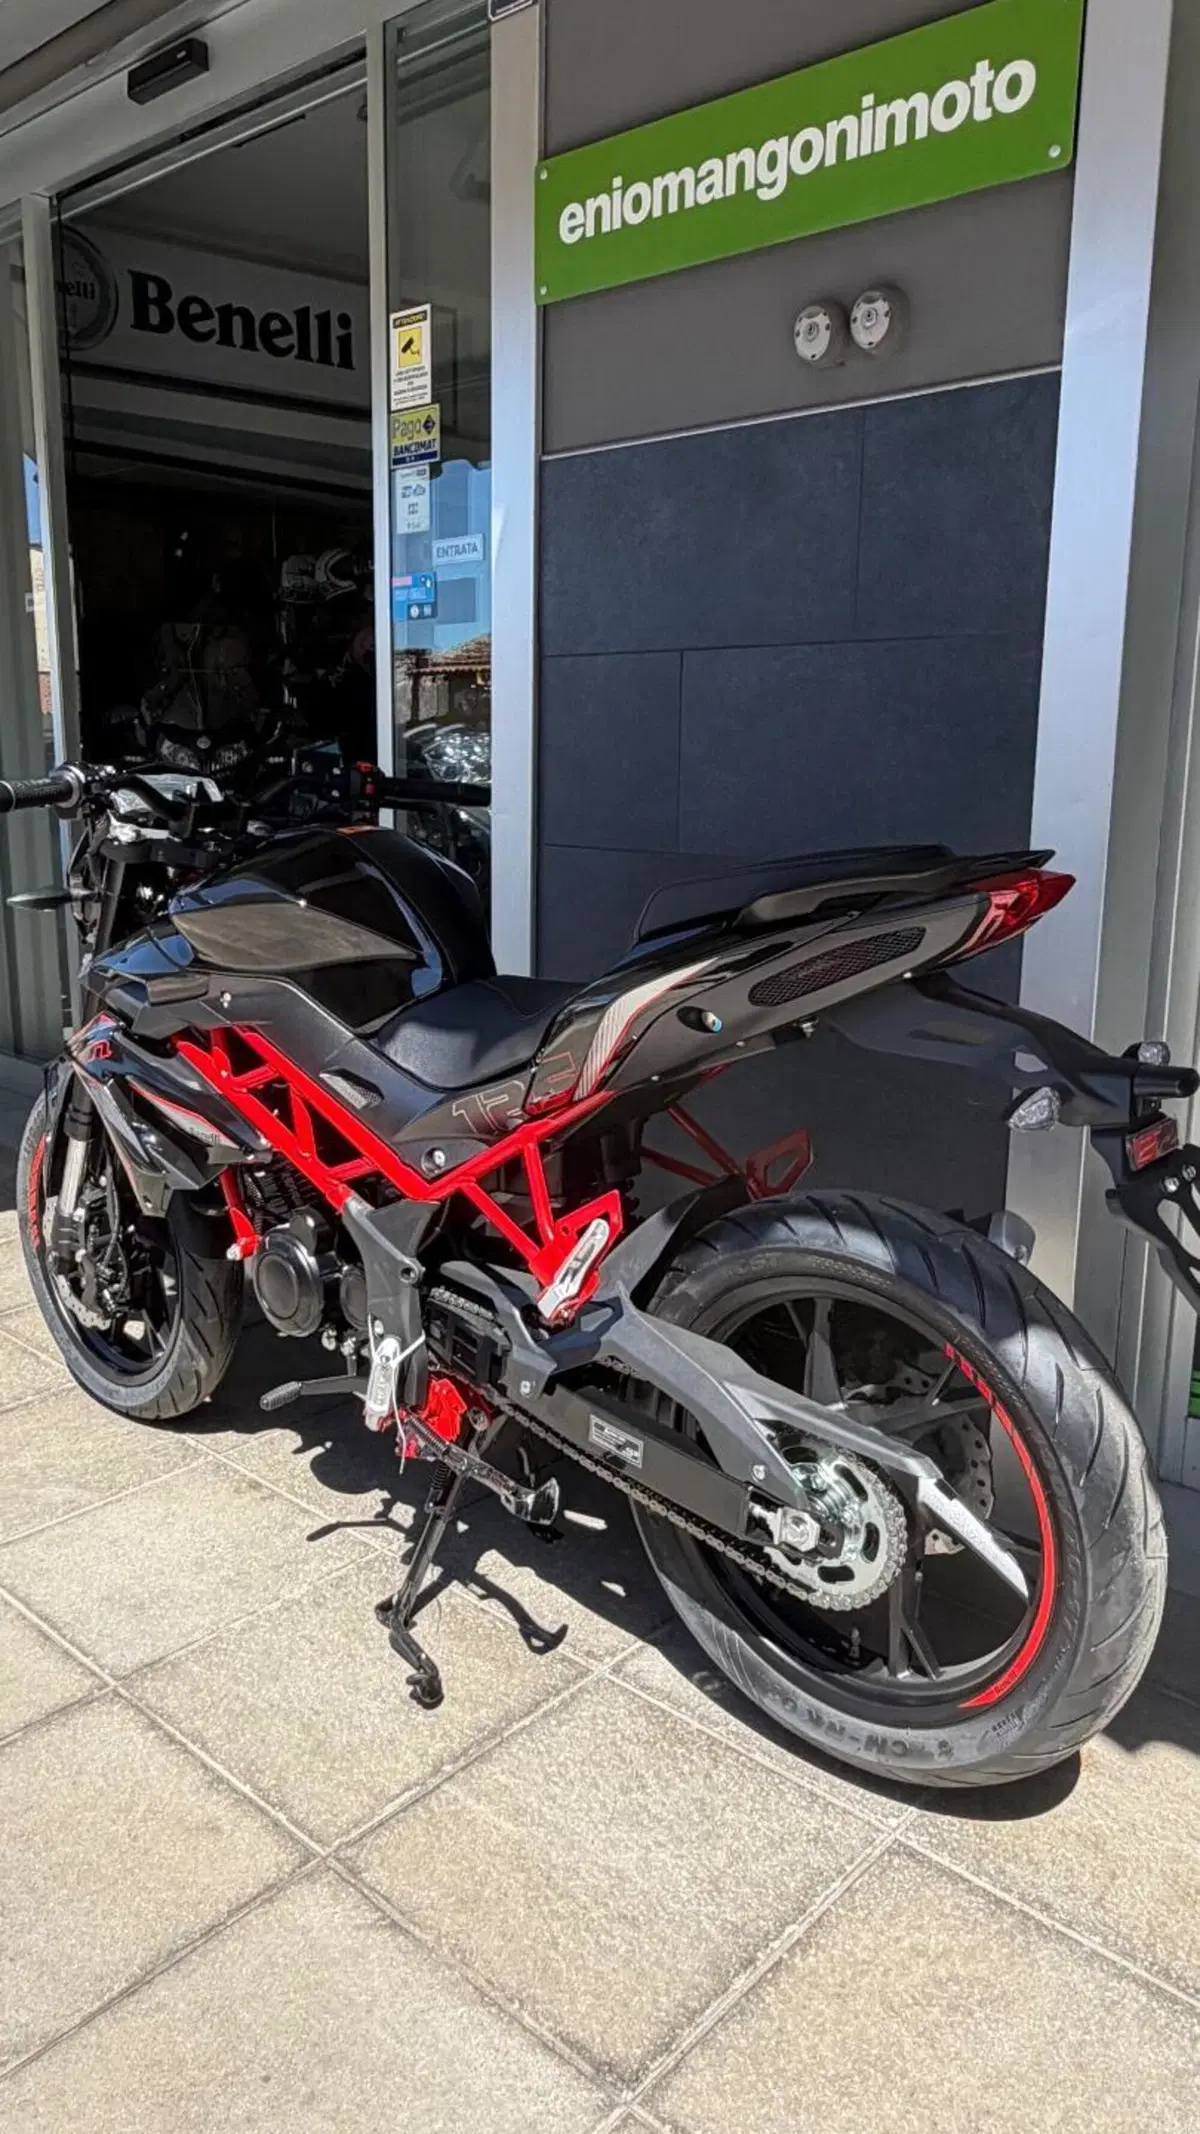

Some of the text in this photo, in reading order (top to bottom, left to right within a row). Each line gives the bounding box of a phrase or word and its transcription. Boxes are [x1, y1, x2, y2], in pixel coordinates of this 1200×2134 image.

[558, 58, 1037, 245] eniomangonimoto
[127, 268, 356, 371] Benelli
[392, 417, 422, 441] Pago
[394, 438, 437, 458] BANCOMAT
[436, 541, 479, 558] ENTRATA
